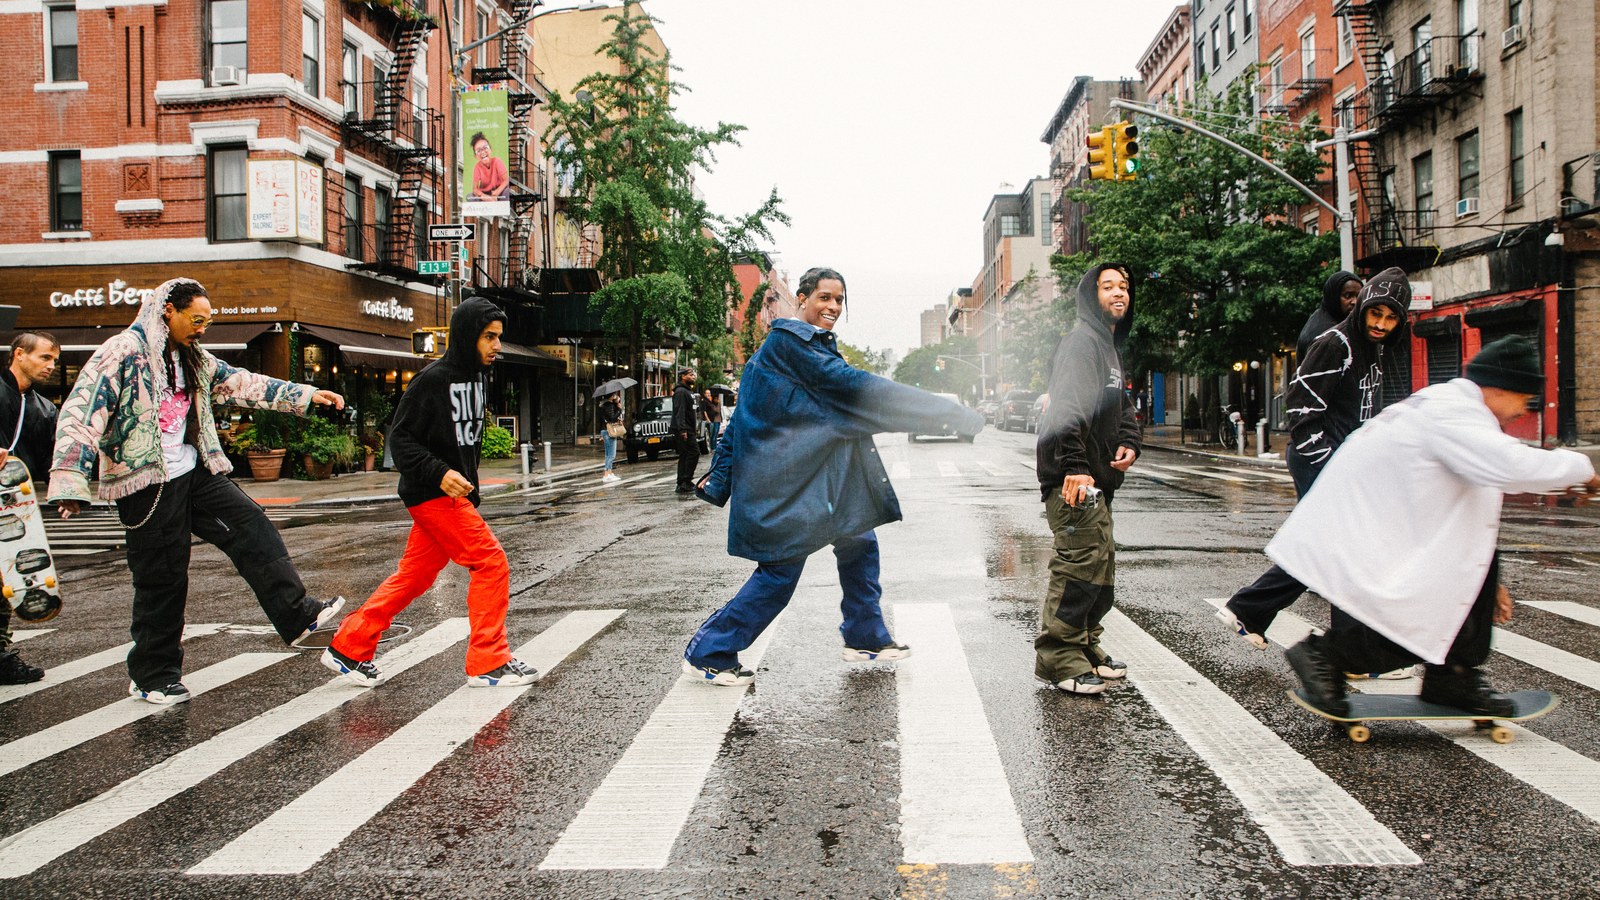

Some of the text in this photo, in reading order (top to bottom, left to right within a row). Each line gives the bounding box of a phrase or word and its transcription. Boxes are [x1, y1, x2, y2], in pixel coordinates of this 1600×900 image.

[252, 213, 272, 221] EXPERT
[420, 263, 427, 272] E
[428, 262, 440, 272] 13
[108, 279, 154, 305] ben
[221, 306, 238, 314] food
[240, 306, 258, 314] beer
[260, 305, 278, 313] wine
[390, 297, 414, 322] bene
